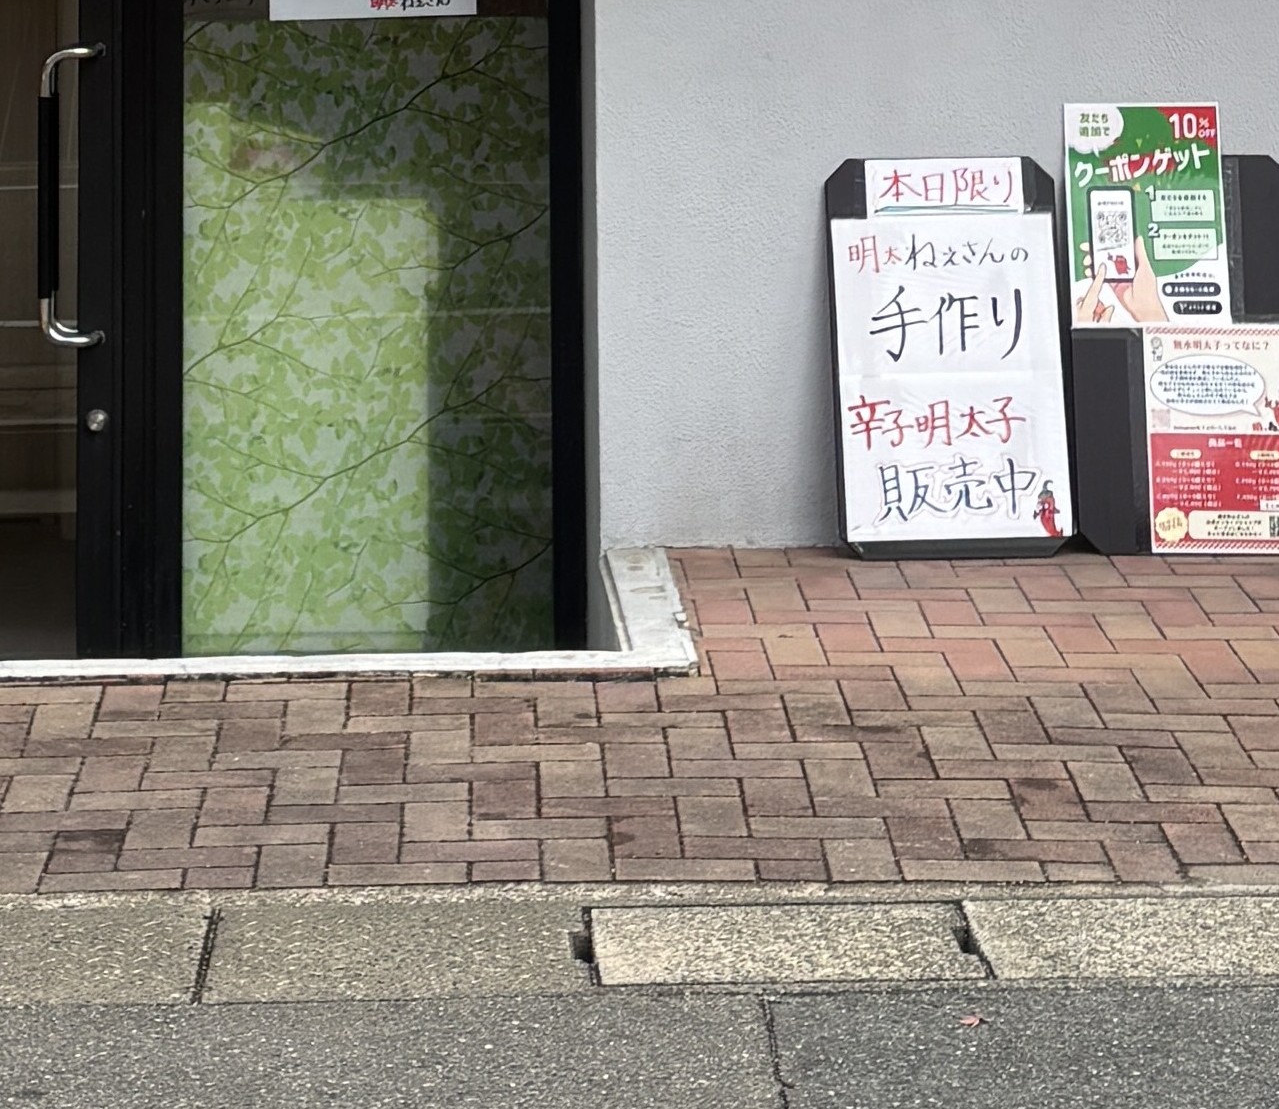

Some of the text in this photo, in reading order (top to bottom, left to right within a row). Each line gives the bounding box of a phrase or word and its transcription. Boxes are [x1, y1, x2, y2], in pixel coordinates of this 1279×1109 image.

[879, 167, 1014, 204] 本日限り
[1074, 143, 1210, 188] クーポンゲット
[869, 285, 1022, 362] 手作り
[847, 395, 1028, 452] 辛子明太子
[878, 457, 1037, 521] 販売中
